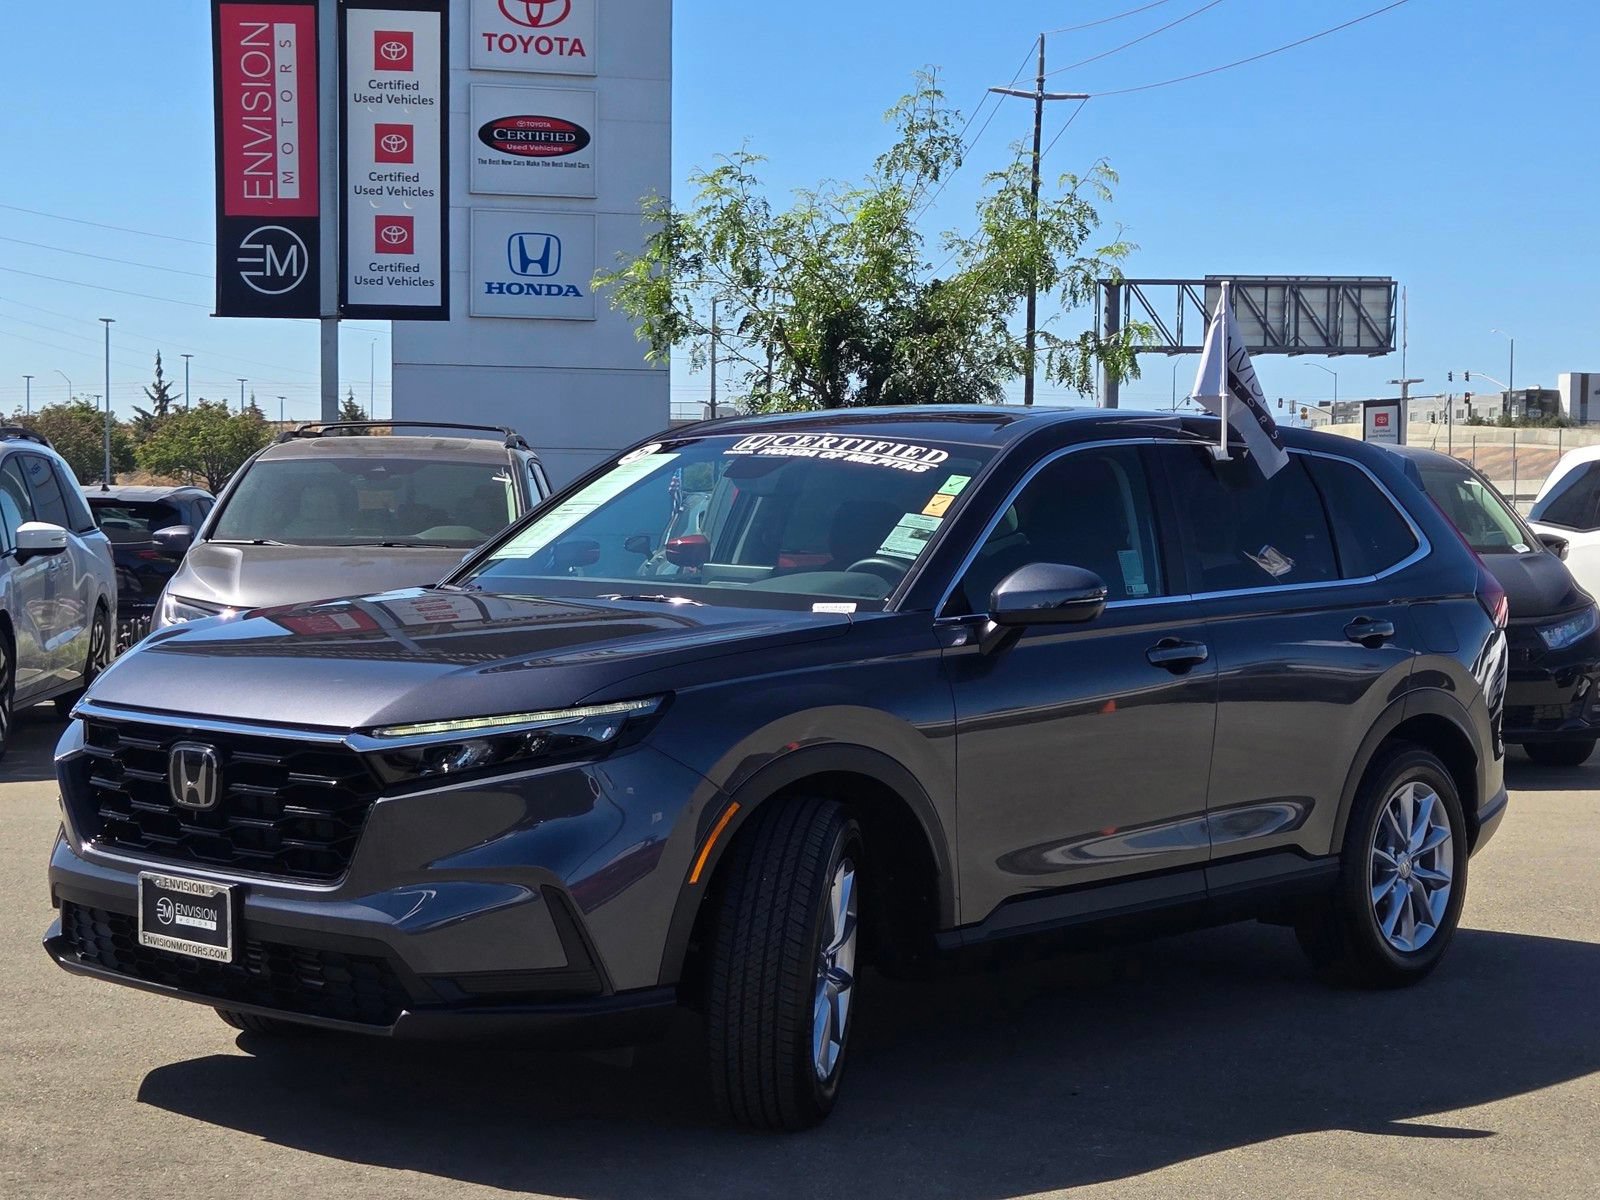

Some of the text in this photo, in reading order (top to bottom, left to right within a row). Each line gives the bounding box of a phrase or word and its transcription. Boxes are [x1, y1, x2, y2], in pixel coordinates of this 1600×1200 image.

[482, 32, 586, 57] TOYOTA
[367, 79, 420, 91] Certified
[352, 93, 435, 106] Used Vehicles
[239, 22, 274, 200] ENVISION
[279, 38, 295, 184] MOTORS
[493, 128, 576, 142] CERTIFIED
[529, 144, 563, 152] Vehicles
[488, 158, 501, 166] Best
[513, 159, 526, 167] Cars
[367, 172, 420, 183] Certified
[353, 184, 435, 198] Used Vehicles
[368, 262, 420, 273] Certified
[353, 275, 435, 288] Used Vehicles
[485, 281, 583, 298] HONDA
[772, 434, 949, 465] CERTIFIED
[842, 454, 930, 474] MILPITAS
[164, 877, 205, 894] ENVISION
[175, 902, 217, 921] ENVISION
[143, 933, 227, 960] ENVISIONMOTORS.COM
